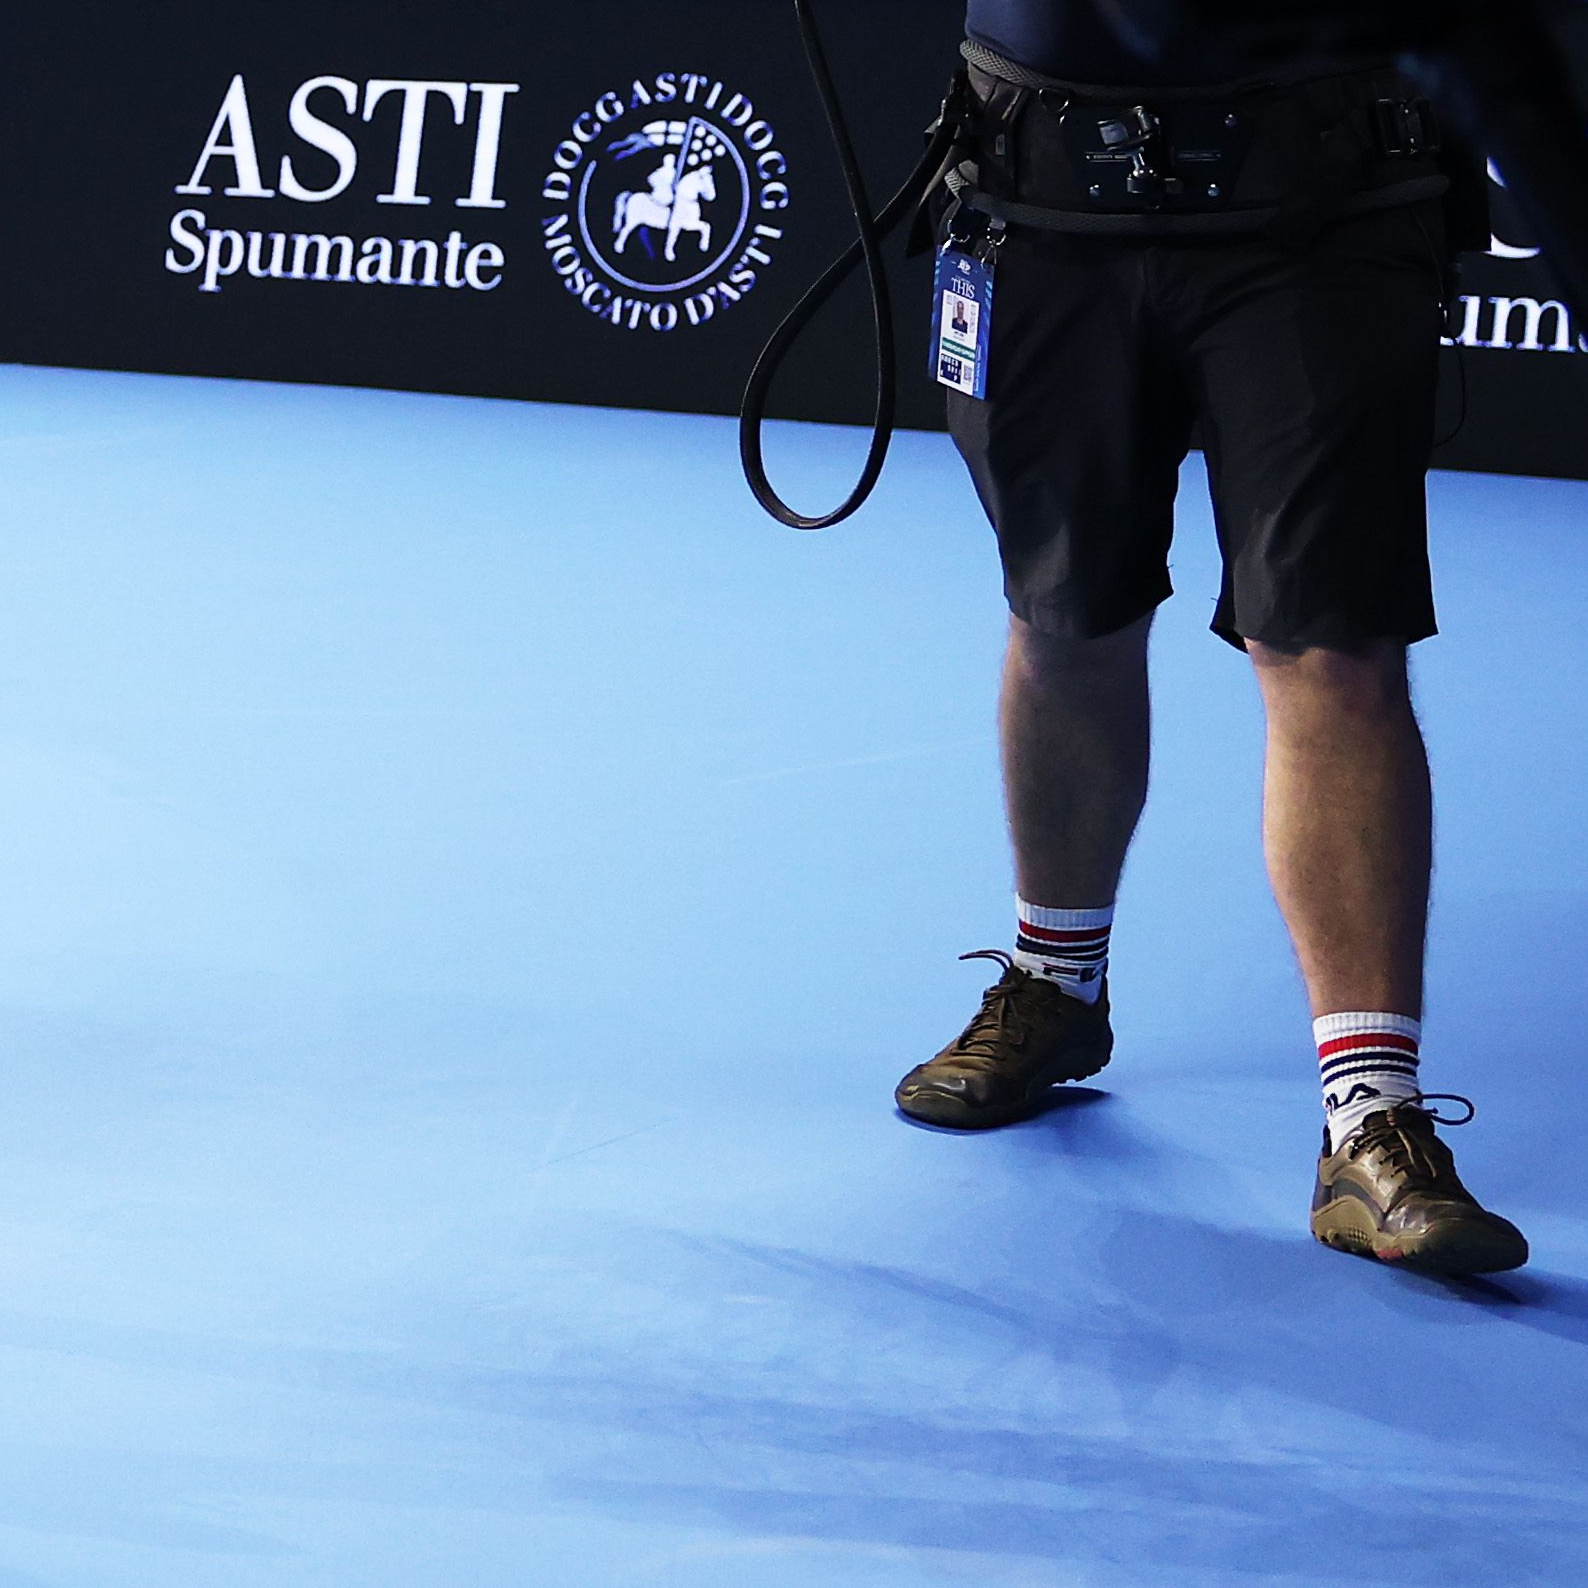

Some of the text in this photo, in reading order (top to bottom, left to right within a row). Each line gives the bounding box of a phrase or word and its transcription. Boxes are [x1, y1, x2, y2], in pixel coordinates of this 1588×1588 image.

[174, 74, 520, 209] ASTI
[542, 72, 789, 210] DOCG ASTI DOCG
[165, 208, 506, 293] Spumante
[541, 214, 678, 332] MOSCATO
